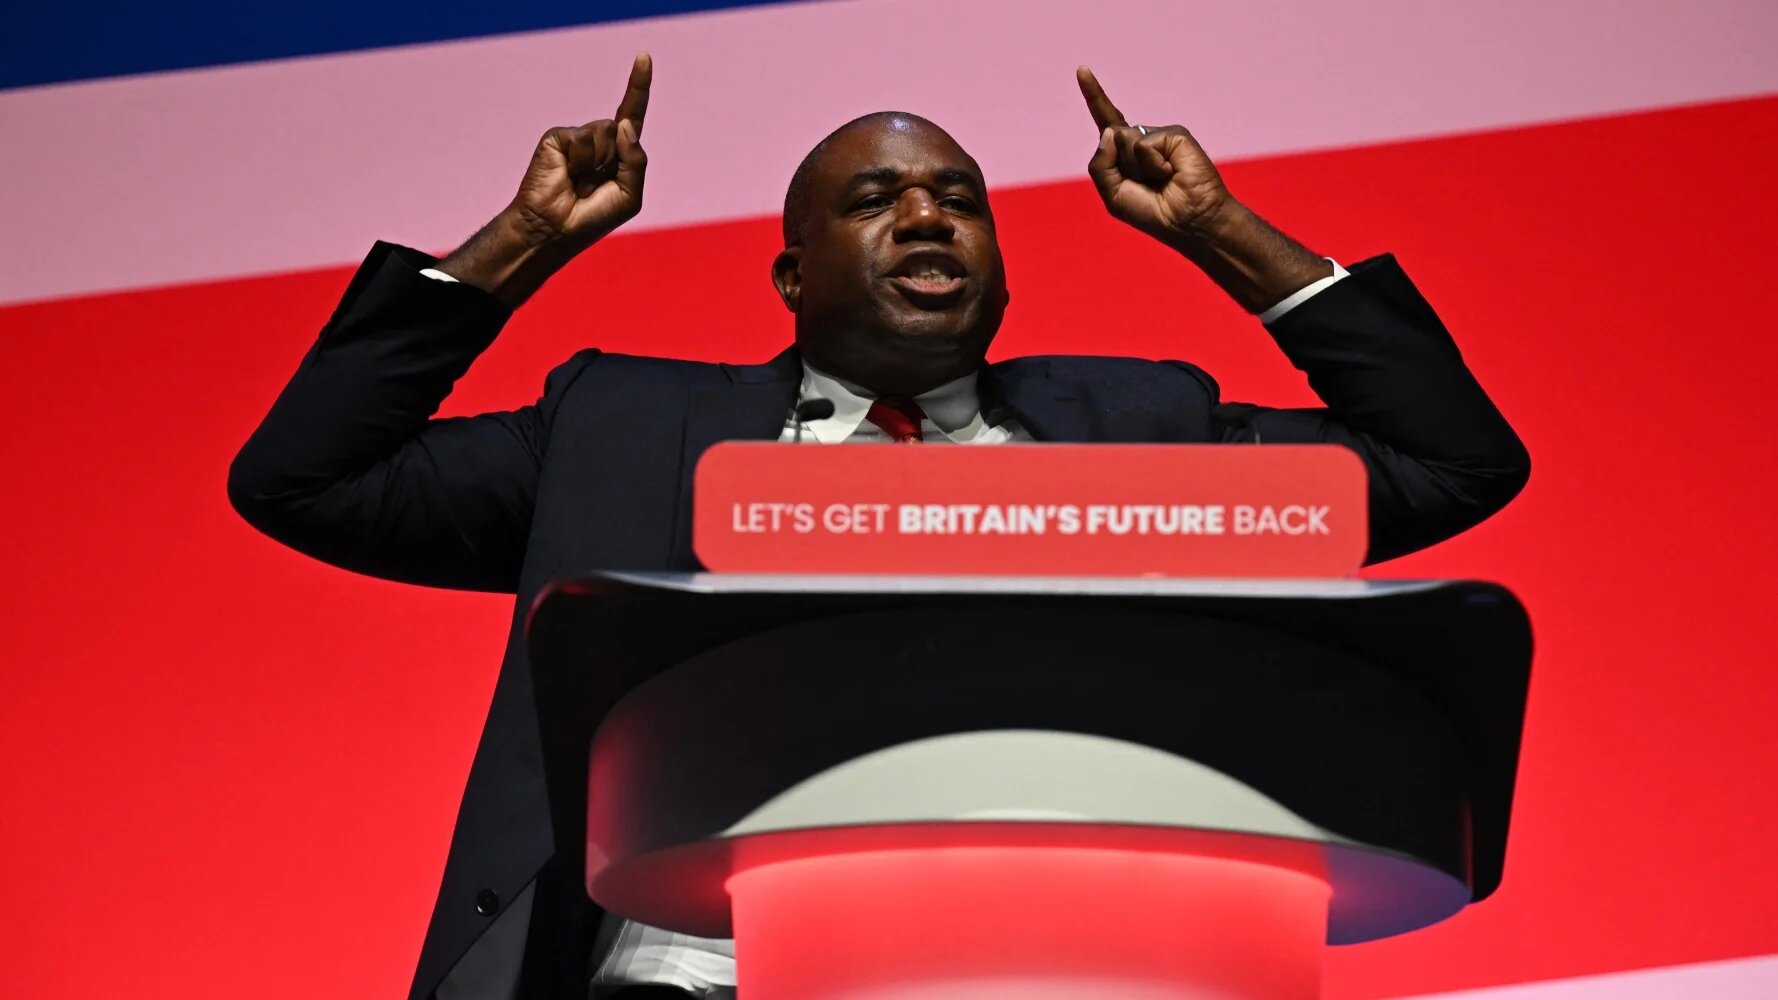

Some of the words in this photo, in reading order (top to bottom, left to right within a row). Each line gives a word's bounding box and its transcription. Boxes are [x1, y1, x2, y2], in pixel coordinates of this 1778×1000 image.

[733, 503, 815, 533] LET’S
[823, 503, 889, 533] GET
[898, 503, 1081, 535] BRITAIN’S
[1086, 504, 1225, 535] FUTURE
[1233, 504, 1330, 535] BACK
